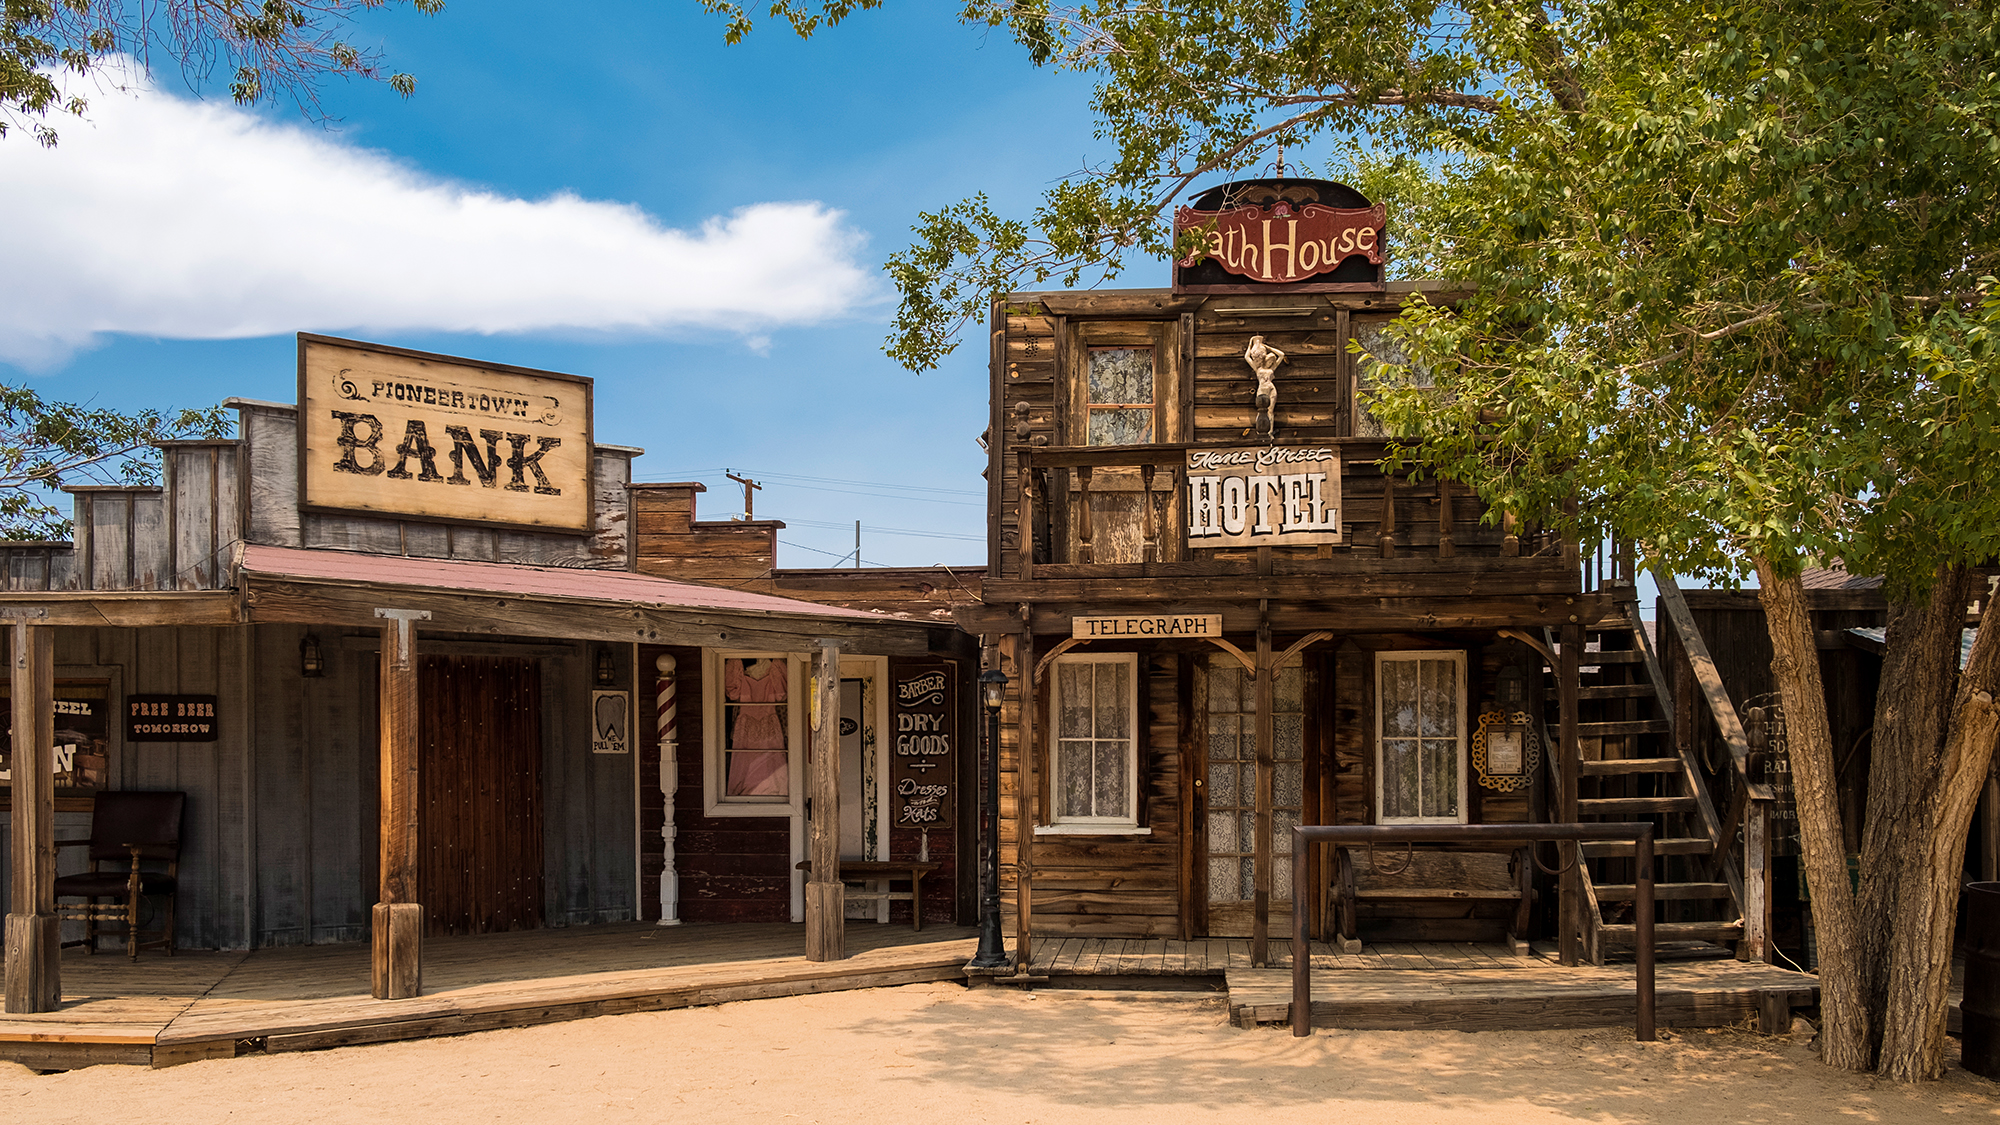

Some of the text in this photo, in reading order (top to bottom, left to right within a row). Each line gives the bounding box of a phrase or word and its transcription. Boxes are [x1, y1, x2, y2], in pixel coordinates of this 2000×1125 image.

[372, 379, 529, 417] PIONEERTOWN
[331, 410, 561, 496] BANK
[1188, 446, 1333, 473] Mane Street
[1188, 472, 1338, 538] HOTEL
[1086, 618, 1207, 635] TELEGRAPH
[898, 675, 946, 699] BARBER
[131, 702, 214, 717] FREE BEER
[133, 724, 210, 734] TOMORROW
[897, 713, 945, 732] DRY
[593, 741, 609, 750] PULL
[896, 734, 950, 755] GOODS
[897, 778, 948, 797] Dresses
[900, 806, 937, 823] Hats
